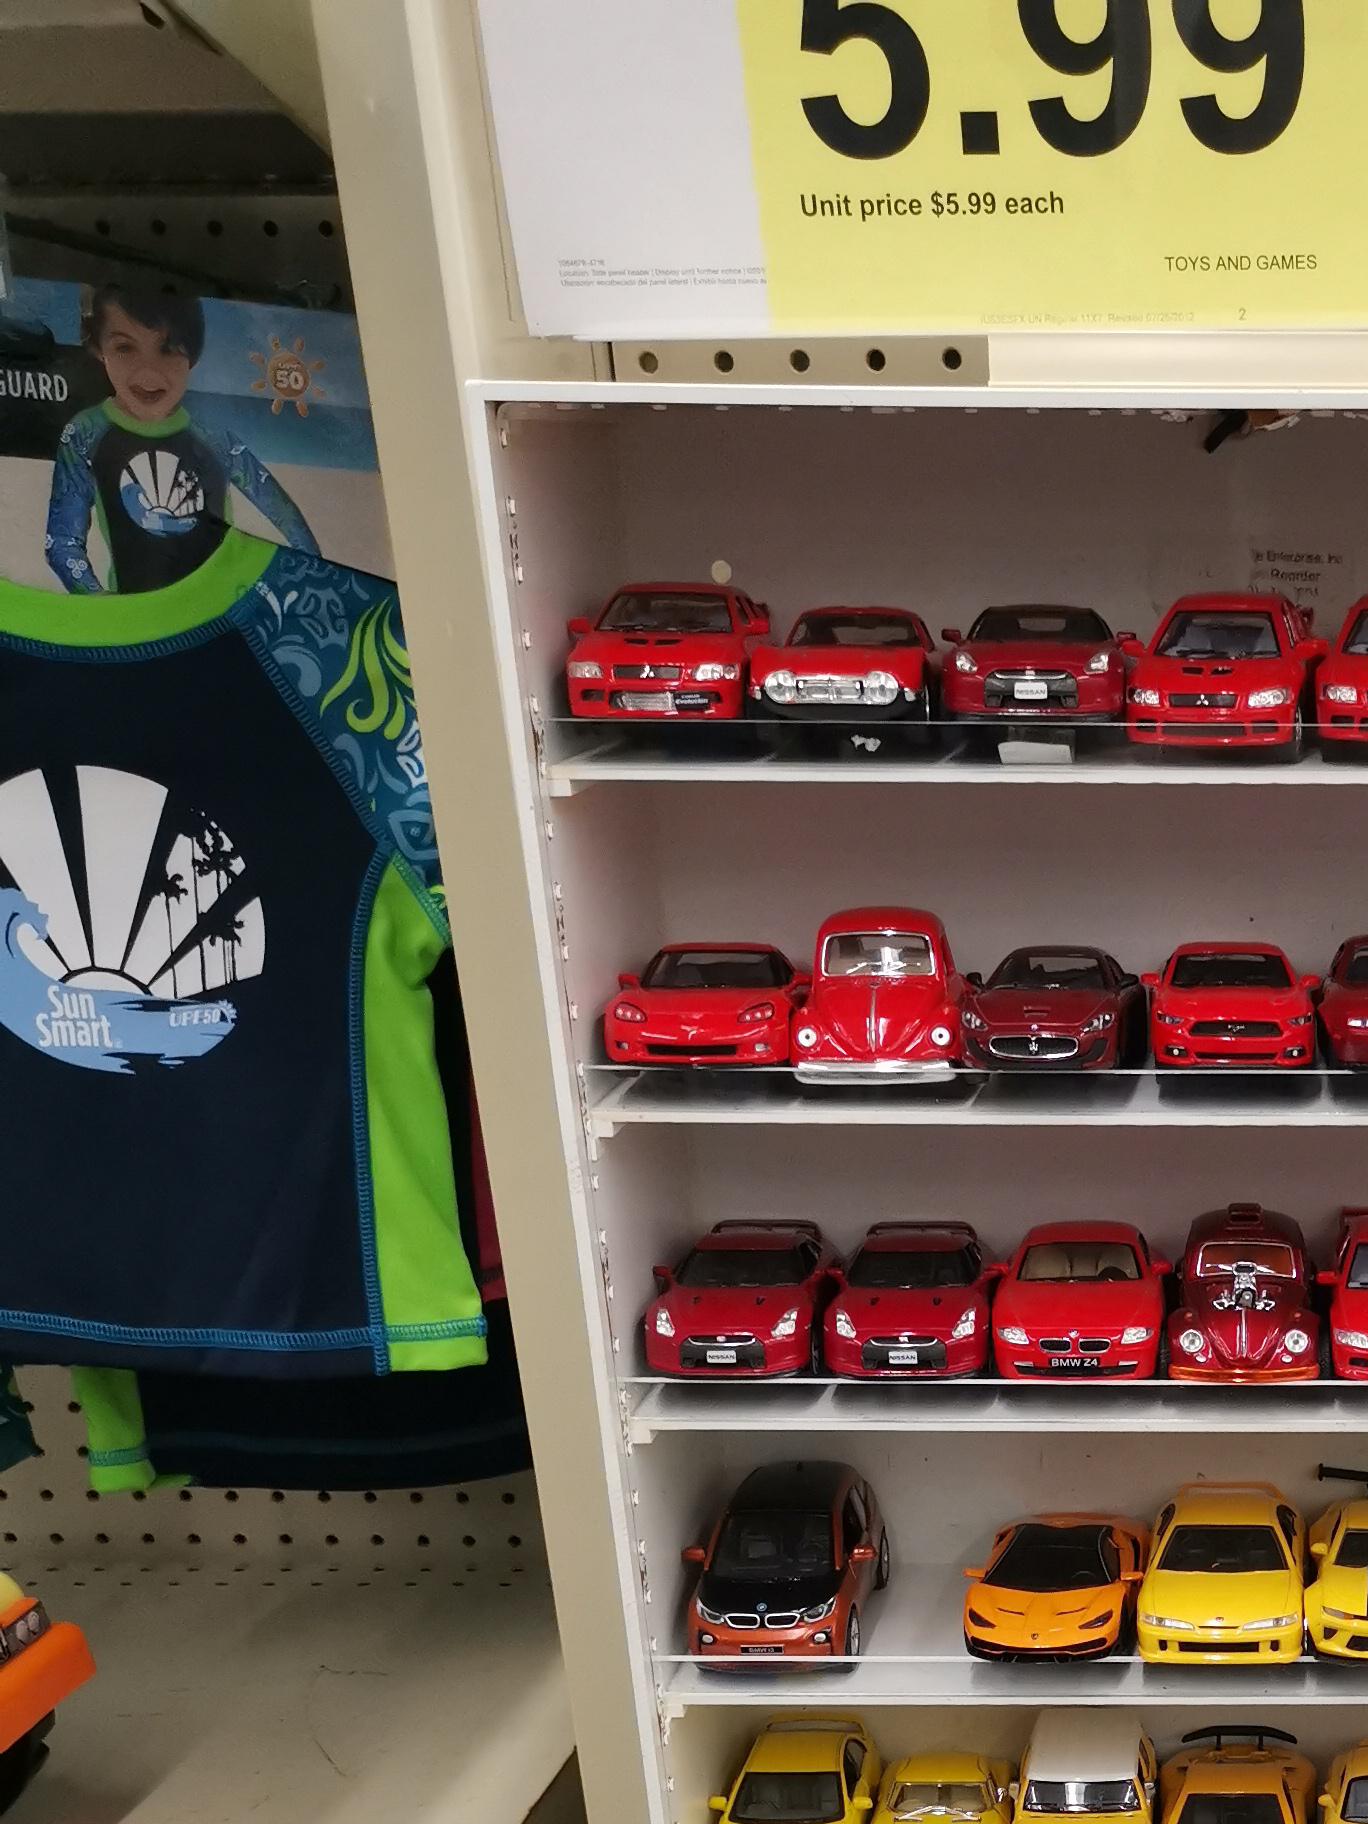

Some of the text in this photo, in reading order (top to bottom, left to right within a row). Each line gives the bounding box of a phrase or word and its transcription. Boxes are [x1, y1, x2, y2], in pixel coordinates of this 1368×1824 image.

[800, 0, 1305, 160] 5.99
[800, 191, 1065, 222] Unit price $5.99 each
[1164, 254, 1318, 271] TOYS AND GAMES
[1239, 307, 1247, 321] 2
[276, 369, 304, 390] 50
[48, 985, 97, 1019] Sun
[36, 1013, 112, 1048] Smart
[1051, 1359, 1098, 1367] BMW Z4
